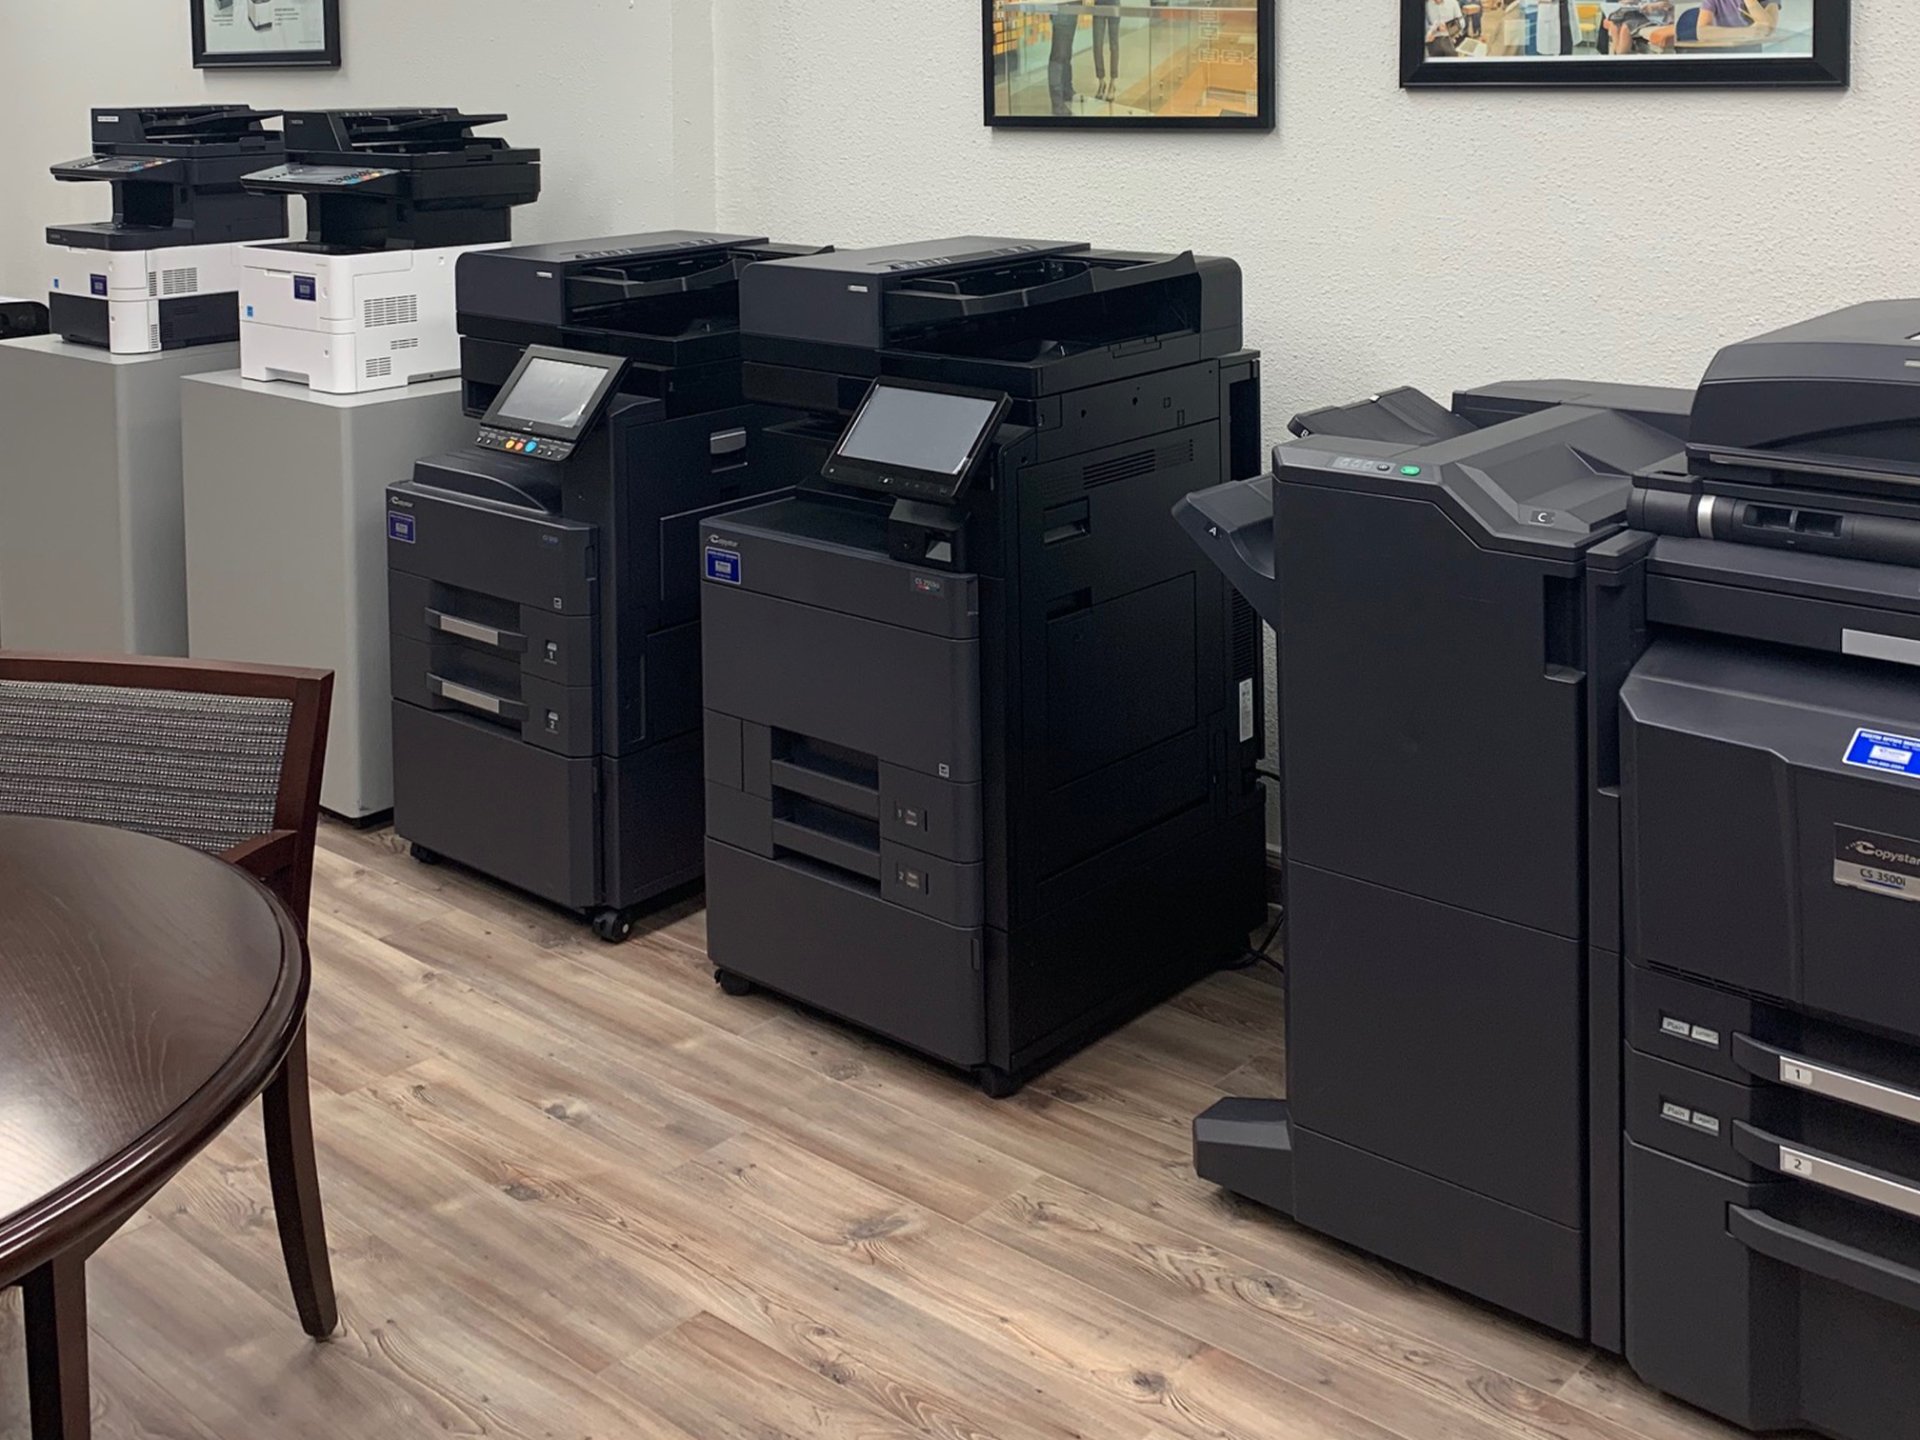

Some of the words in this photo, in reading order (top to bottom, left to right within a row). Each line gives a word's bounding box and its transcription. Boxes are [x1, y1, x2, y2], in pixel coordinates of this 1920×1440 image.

[1537, 512, 1548, 523] C
[1853, 840, 1920, 866] Copystar
[1860, 867, 1873, 879] CS
[1876, 871, 1906, 886] 3500i
[1666, 1021, 1686, 1032] Plain
[1795, 1069, 1801, 1080] 1
[1667, 1106, 1686, 1118] Plain
[1794, 1158, 1802, 1171] 2
